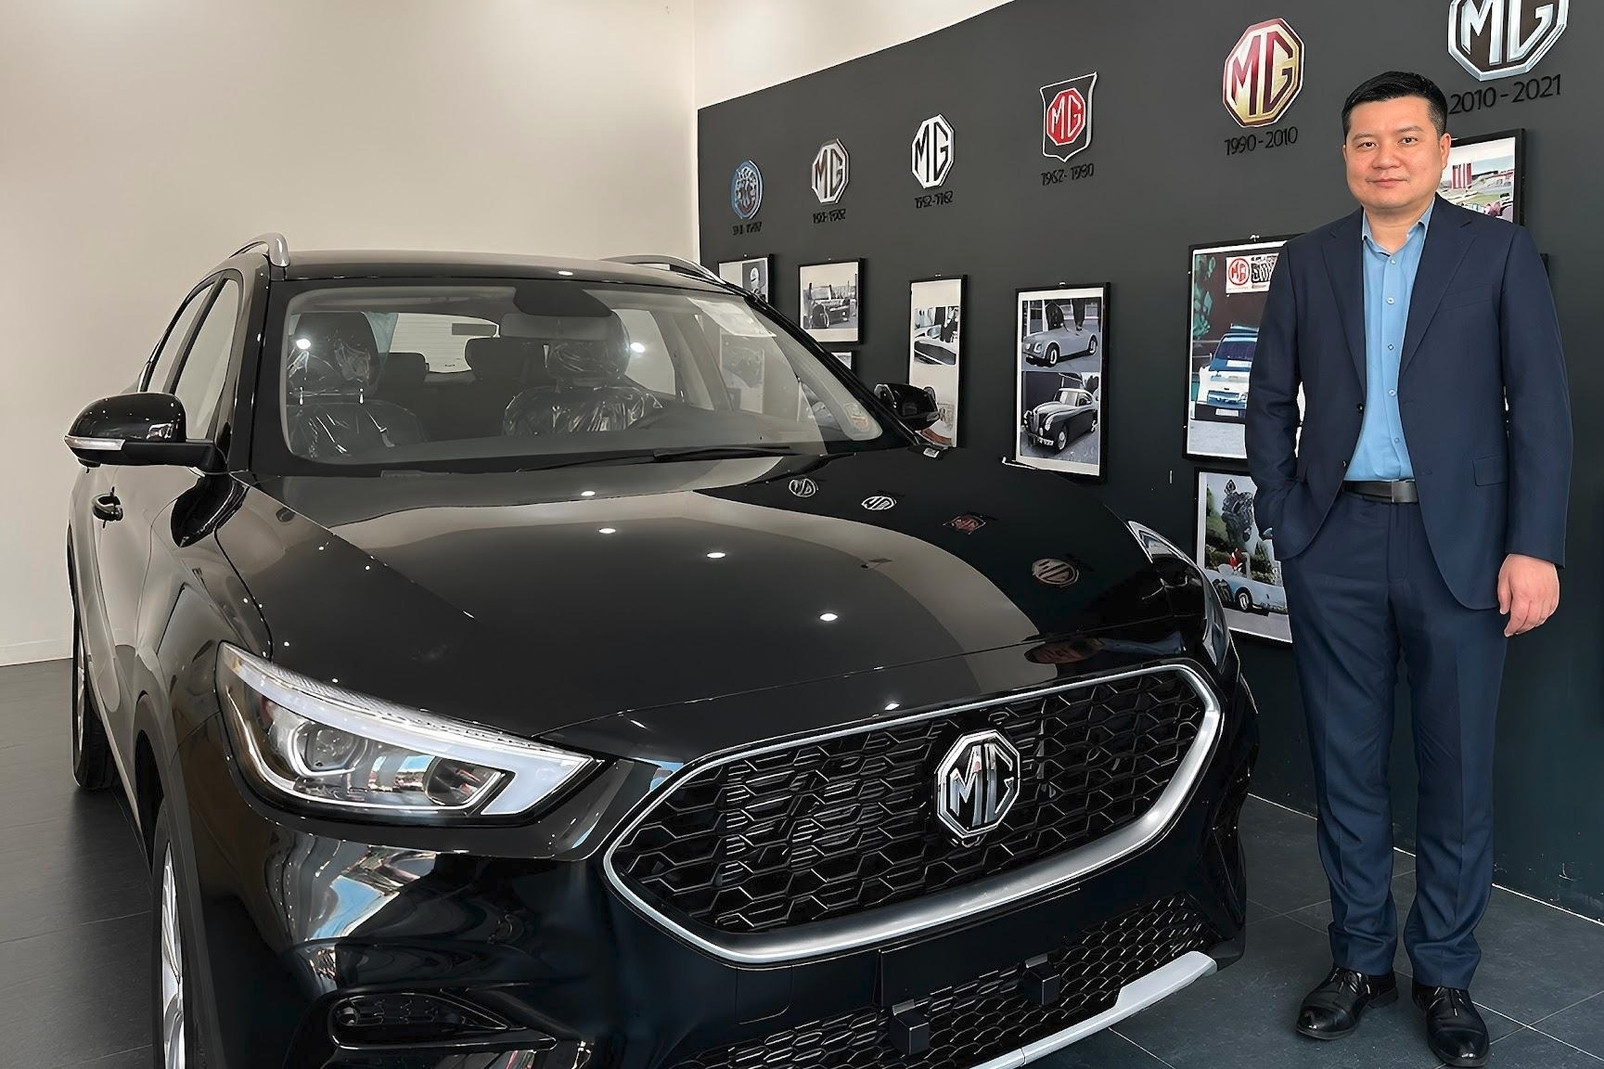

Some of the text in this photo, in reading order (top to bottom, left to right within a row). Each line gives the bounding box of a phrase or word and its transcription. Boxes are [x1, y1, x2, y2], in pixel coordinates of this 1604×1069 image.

[1460, 0, 1554, 66] MG
[1230, 30, 1294, 117] MG
[1448, 74, 1561, 115] 2010-2021
[1051, 93, 1083, 141] MG
[1224, 126, 1299, 156] 1990-2010
[814, 147, 844, 200] MG
[914, 120, 949, 183] MG
[948, 742, 1015, 828] MG
